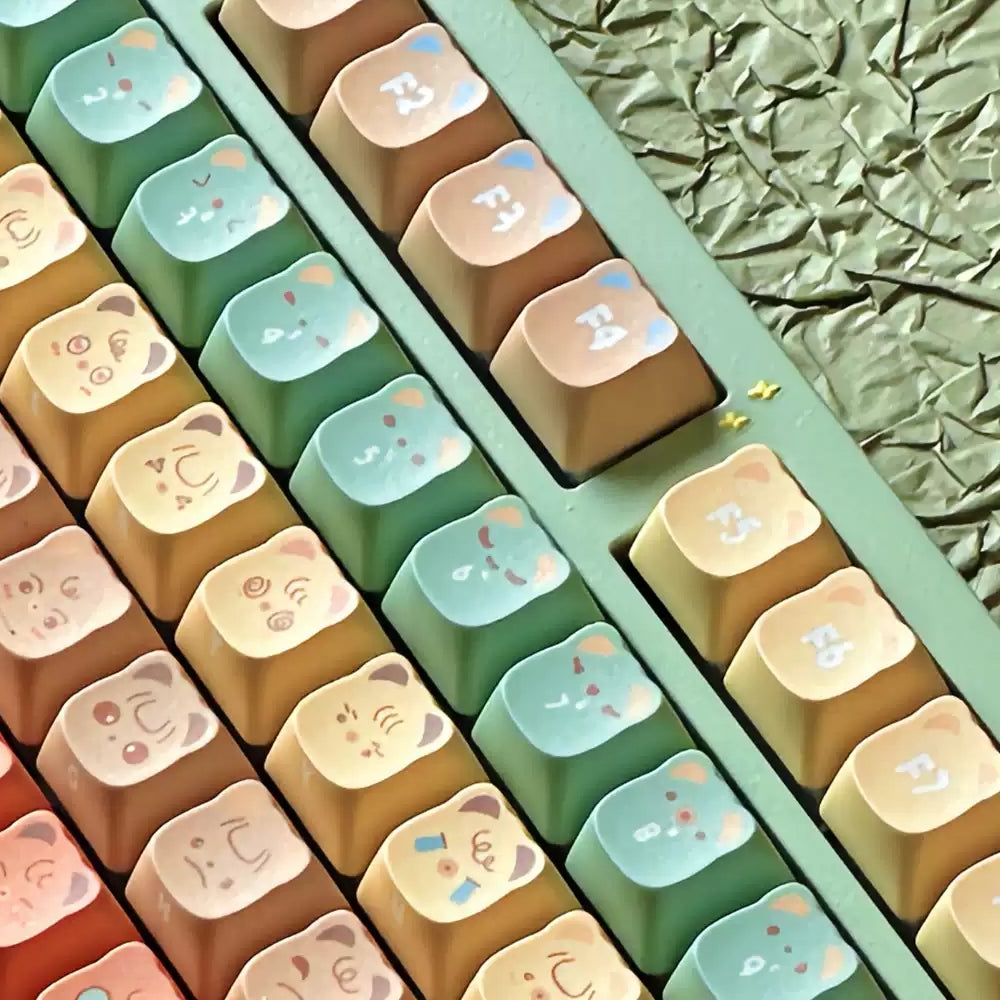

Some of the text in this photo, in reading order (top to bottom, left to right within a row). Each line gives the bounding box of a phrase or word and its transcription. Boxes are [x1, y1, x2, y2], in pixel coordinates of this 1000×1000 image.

[380, 71, 434, 116] F2
[706, 502, 761, 545] F5
[802, 624, 855, 670] F6
[896, 753, 950, 794] F7
